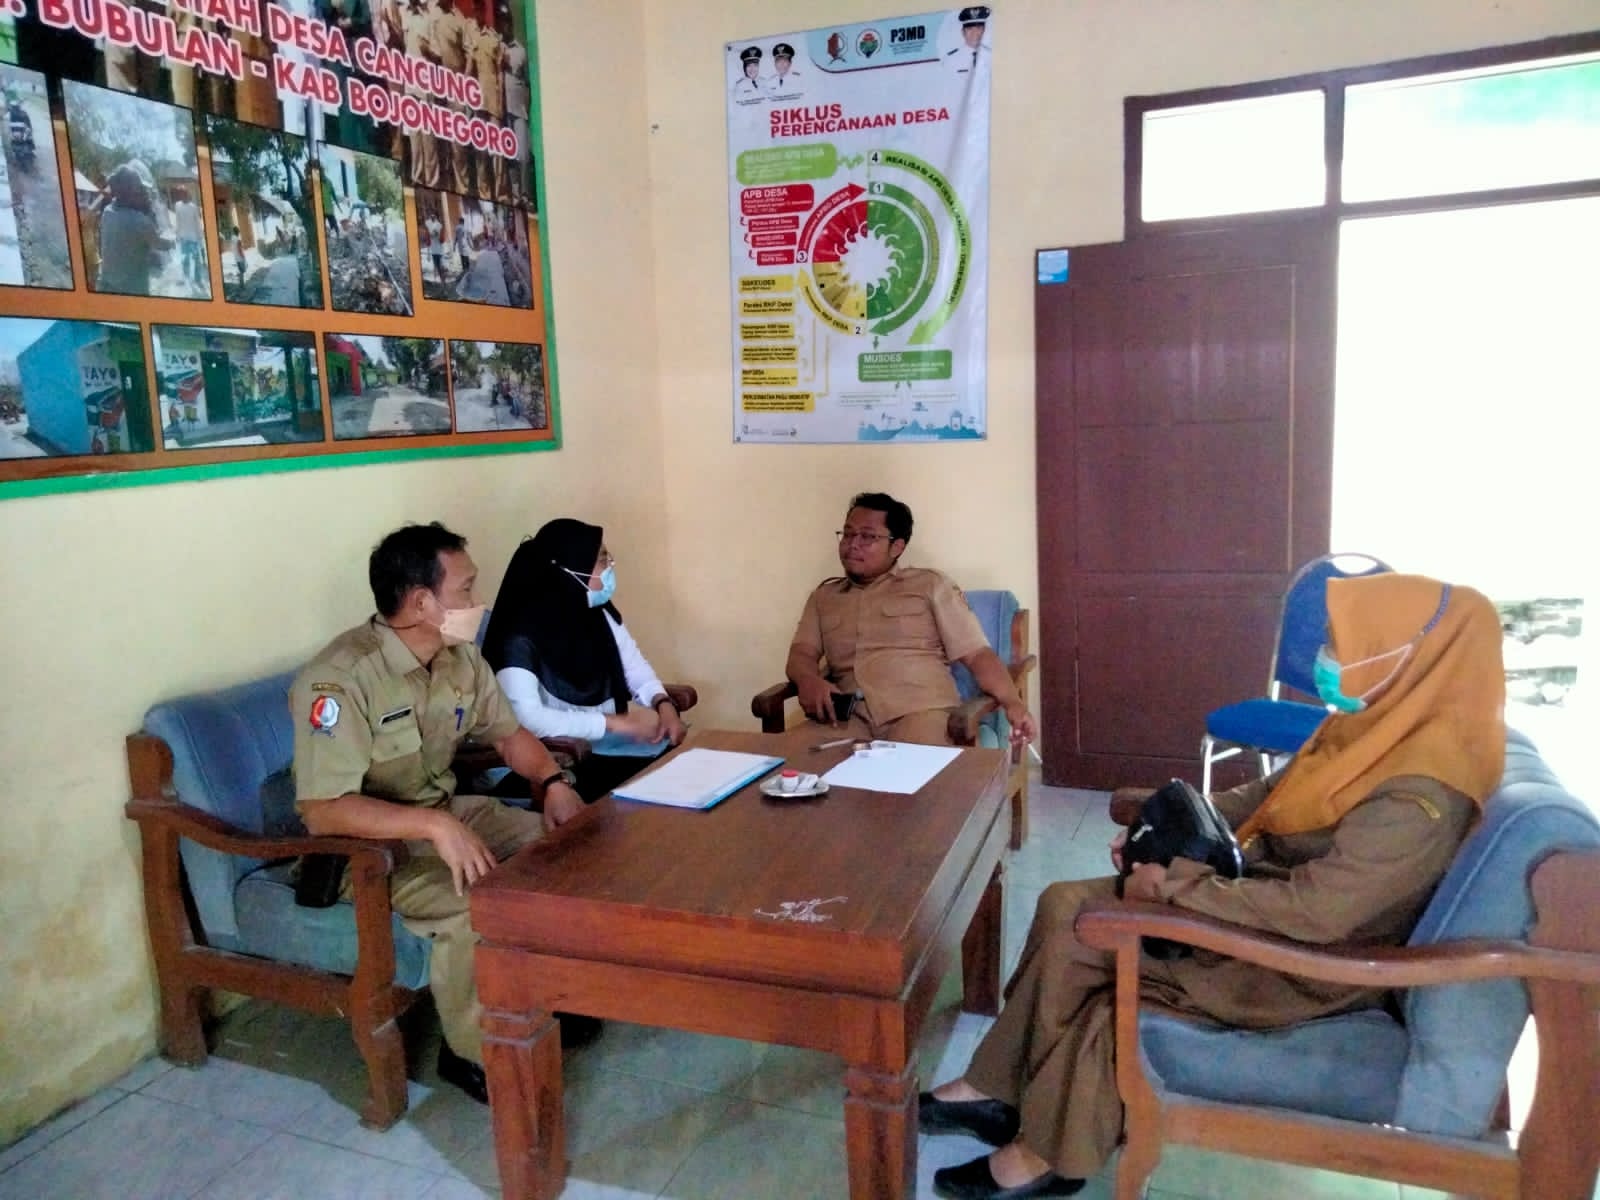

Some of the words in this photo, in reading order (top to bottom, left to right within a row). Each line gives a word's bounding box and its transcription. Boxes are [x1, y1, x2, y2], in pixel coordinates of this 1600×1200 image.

[890, 25, 925, 43] P3MD
[267, 5, 350, 66] DESA
[355, 37, 483, 109] CANCUNG
[41, 0, 243, 79] BUBULAN
[275, 56, 342, 105] KAB
[349, 78, 518, 158] BOJONEGORO
[770, 103, 842, 125] SIKLUS
[770, 113, 897, 138] PERENCANAAN
[903, 107, 949, 125] DESA
[871, 152, 879, 162] 4
[743, 189, 762, 199] APB
[764, 187, 788, 198] DESA
[799, 252, 805, 261] 3
[855, 326, 862, 335] 2
